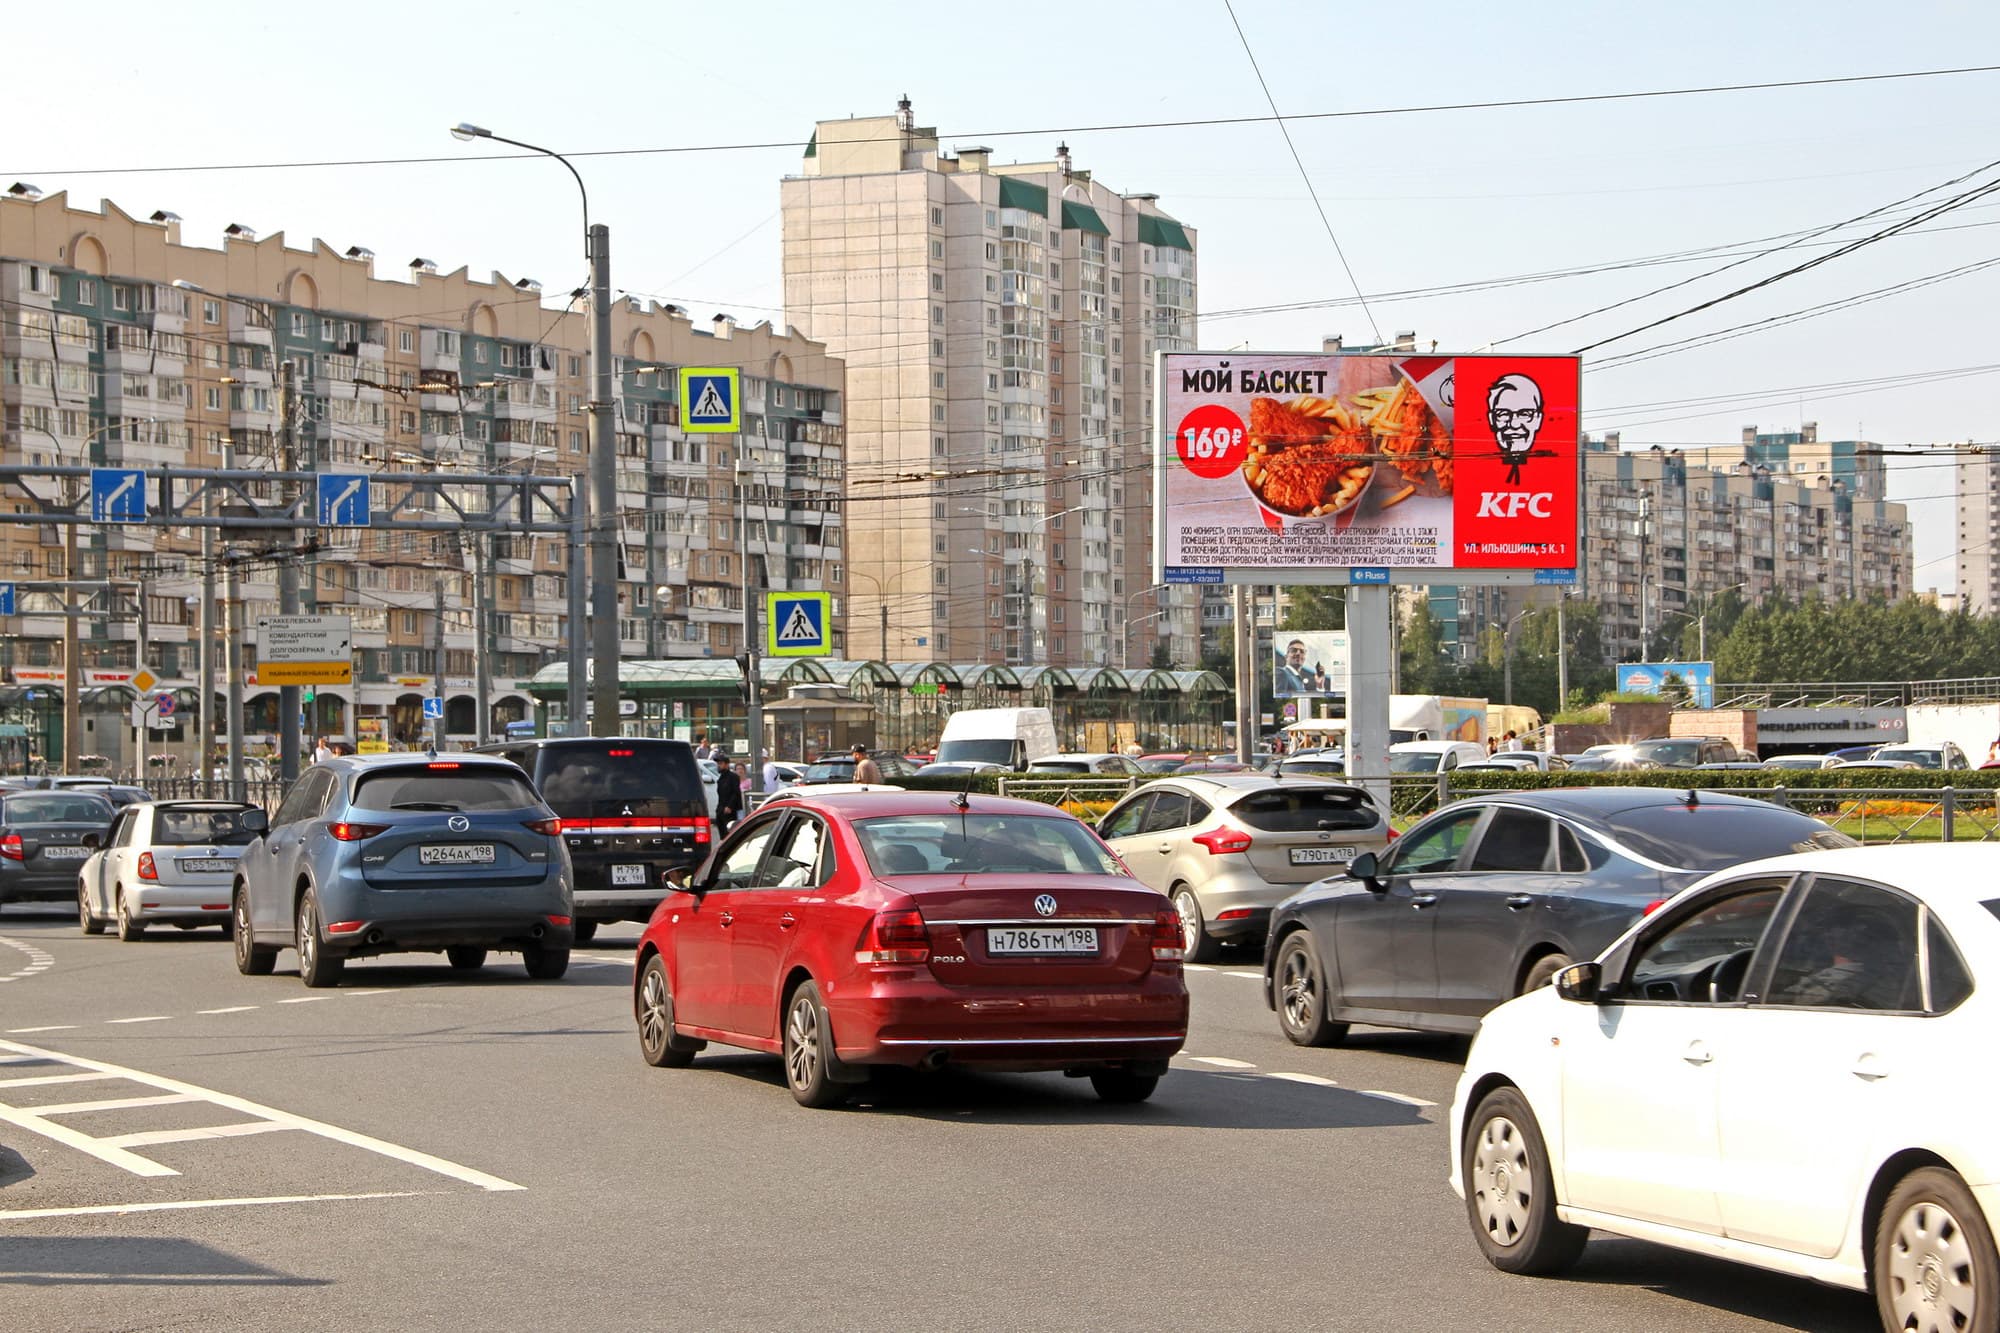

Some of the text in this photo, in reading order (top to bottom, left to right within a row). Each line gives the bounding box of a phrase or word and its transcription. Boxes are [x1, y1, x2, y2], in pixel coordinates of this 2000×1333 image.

[1182, 361, 1328, 394] МОЙ БАСКЕТ
[1476, 492, 1552, 518] KFC
[1227, 536, 1268, 545] ПРЕДЛОЖЕНИЕ
[1368, 537, 1401, 545] РЕСТОРАНАХ
[1181, 546, 1218, 554] ИСКЛЮЧЕНИЯ
[1220, 546, 1250, 555] ДОСТУПНЫ
[1464, 544, 1565, 556] УЛ. ИЛЬЮШИНА, 5 К. 1
[1181, 556, 1210, 564] ЯВЛЯЕТСЯ
[1271, 556, 1306, 564] РАССТОЯНИЕ
[1308, 556, 1339, 564] ОКРУГЛЕНО
[1341, 556, 1349, 565] ДО
[1350, 554, 1391, 564] БЛИЖАЙШЕГО
[1365, 571, 1385, 579] Russ
[423, 846, 491, 860] М264АК 198
[1296, 850, 1336, 861] У790ТА
[994, 930, 1093, 950] Н786ТМ 198
